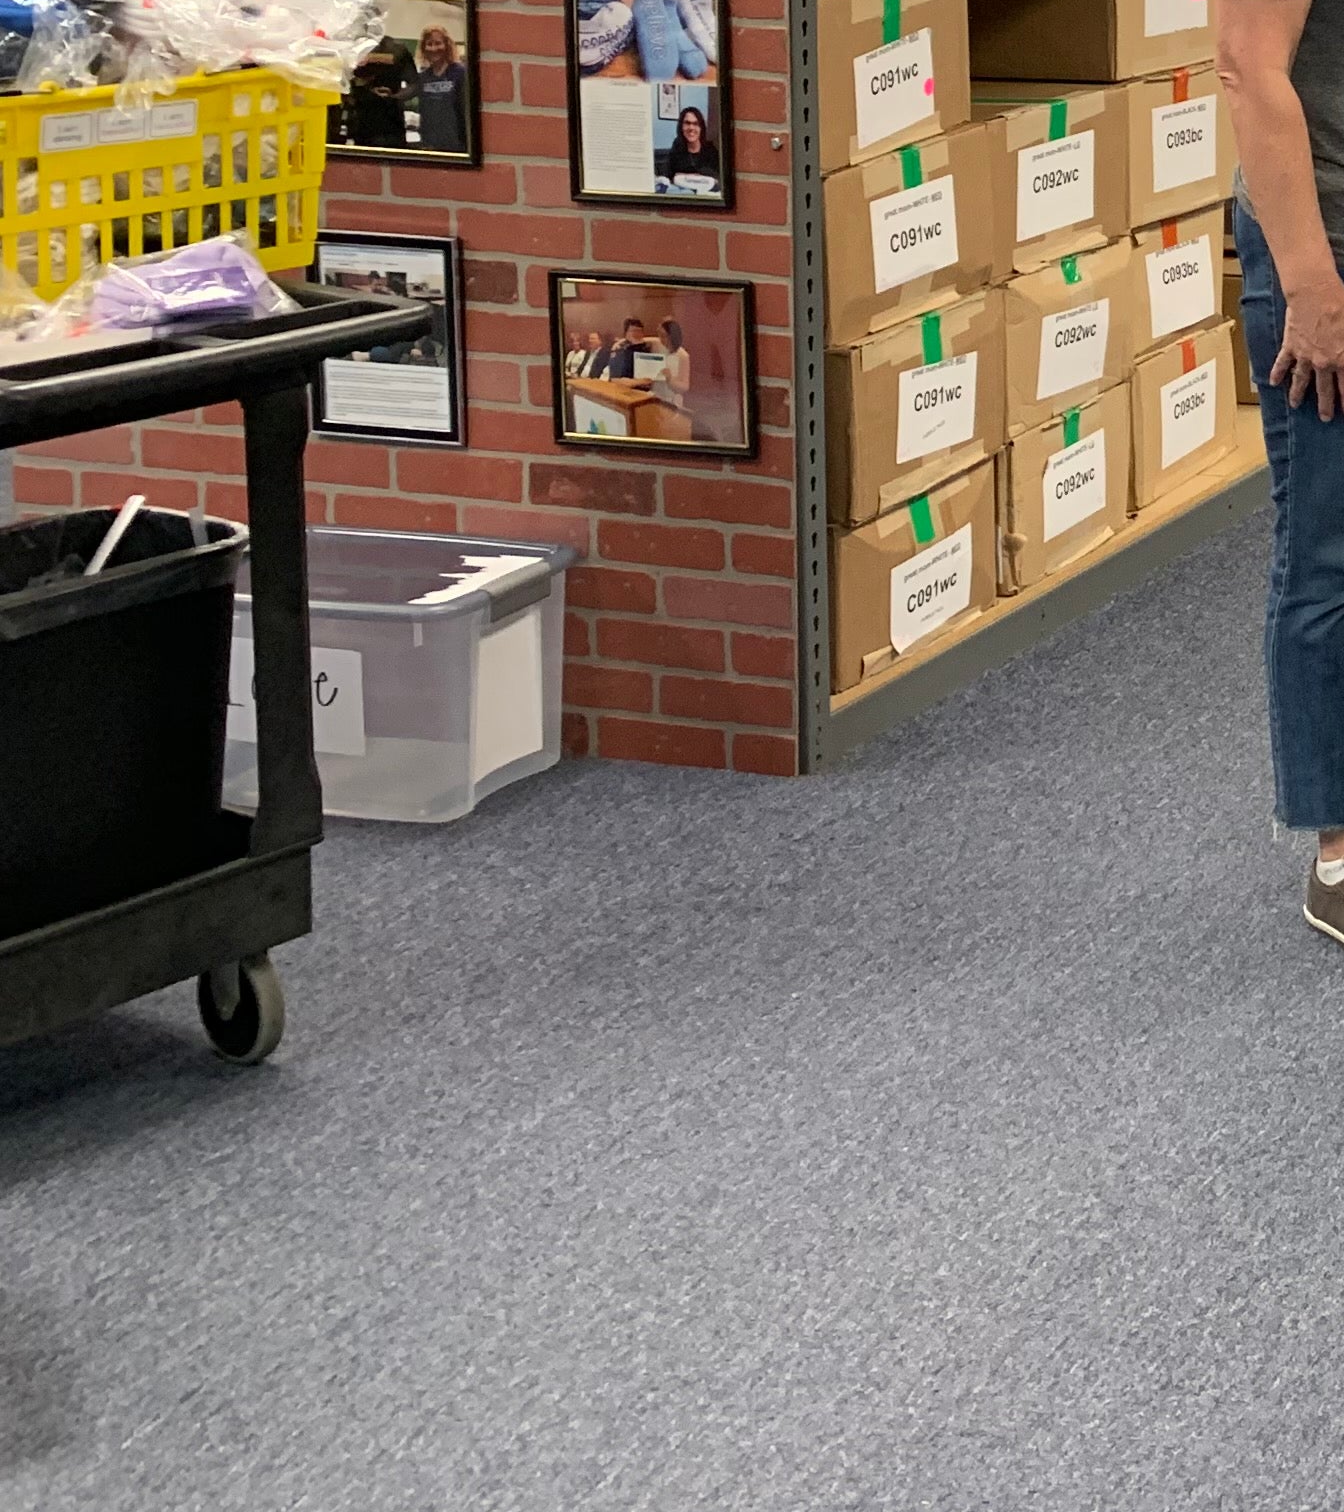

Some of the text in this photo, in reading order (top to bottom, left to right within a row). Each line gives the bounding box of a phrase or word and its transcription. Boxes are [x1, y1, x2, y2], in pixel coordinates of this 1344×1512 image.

[870, 62, 919, 96] C091wc
[1166, 126, 1203, 150] C093bc
[1032, 167, 1079, 195] C092wc
[889, 221, 942, 254] C091wc
[1162, 260, 1199, 286] C093bc
[1054, 323, 1097, 349] C092wc
[913, 384, 962, 413] C091wc
[1173, 390, 1206, 420] C093bc
[1055, 466, 1096, 501] C092wc
[906, 569, 957, 614] C091wc
